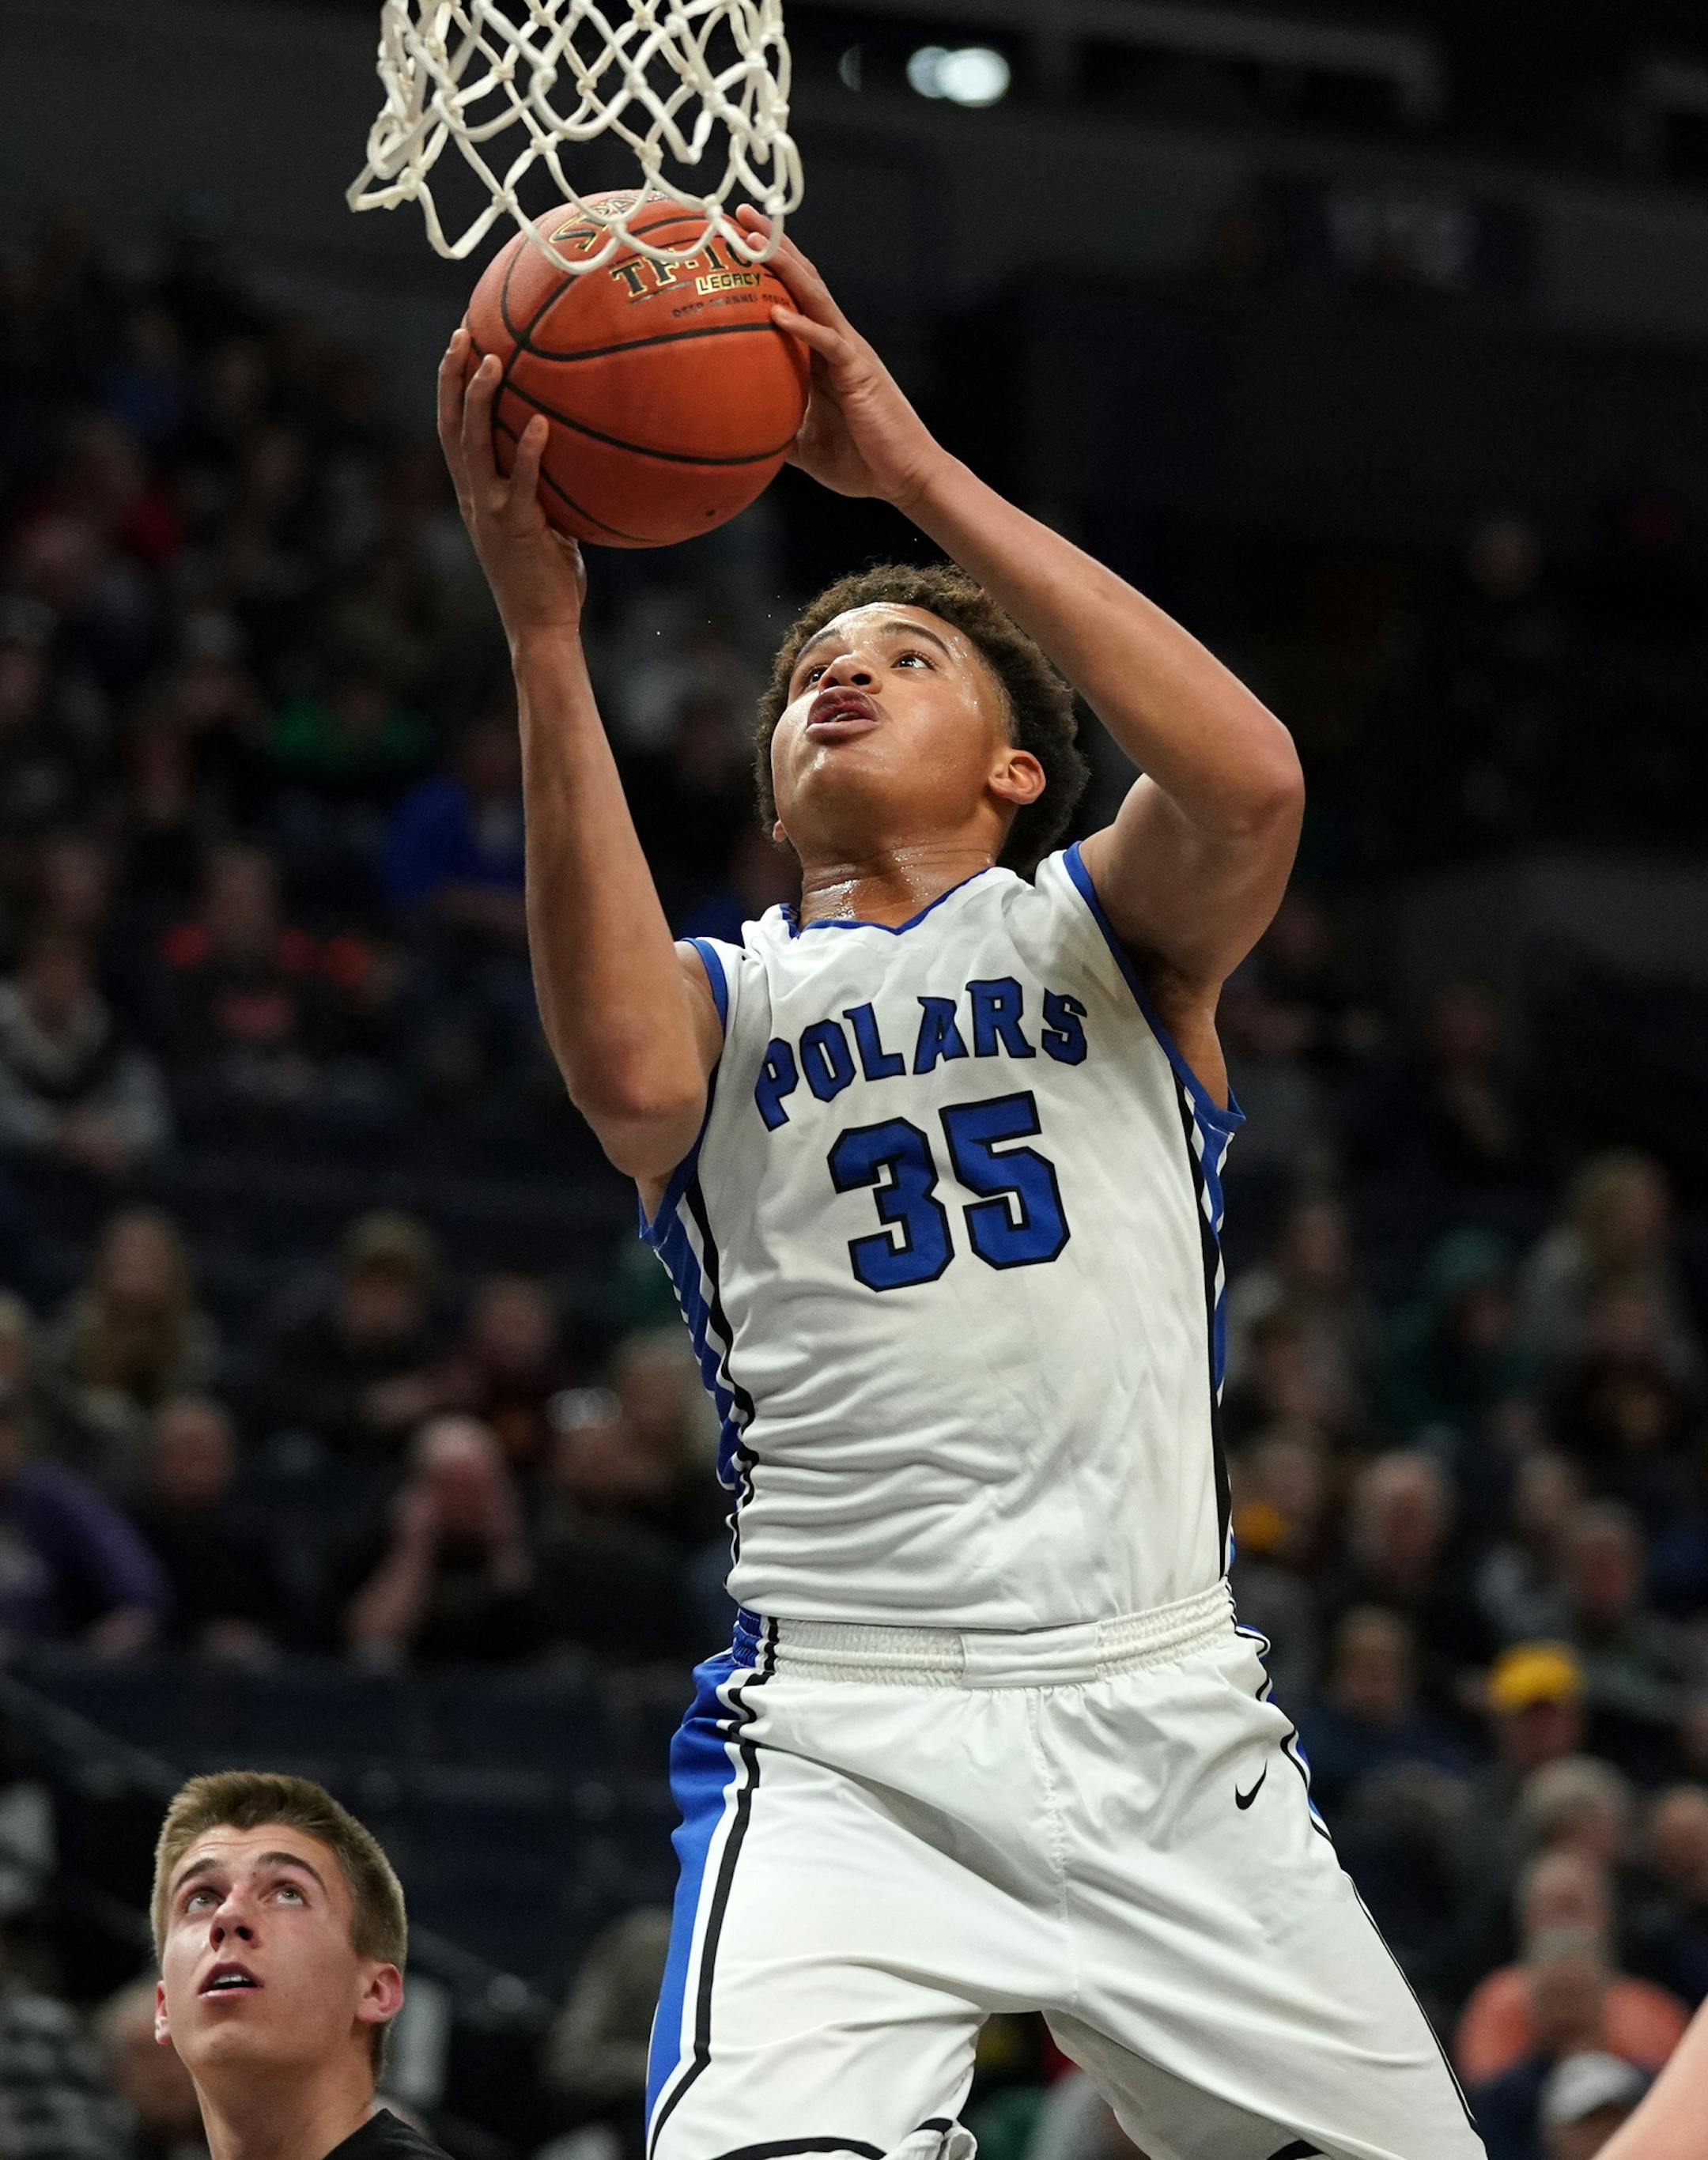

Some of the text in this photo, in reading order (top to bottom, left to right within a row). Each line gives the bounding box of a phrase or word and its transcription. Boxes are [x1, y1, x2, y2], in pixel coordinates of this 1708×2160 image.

[697, 272, 761, 293] LEGACY
[754, 976, 1088, 1132] POLARS
[827, 1089, 1071, 1293] 35
